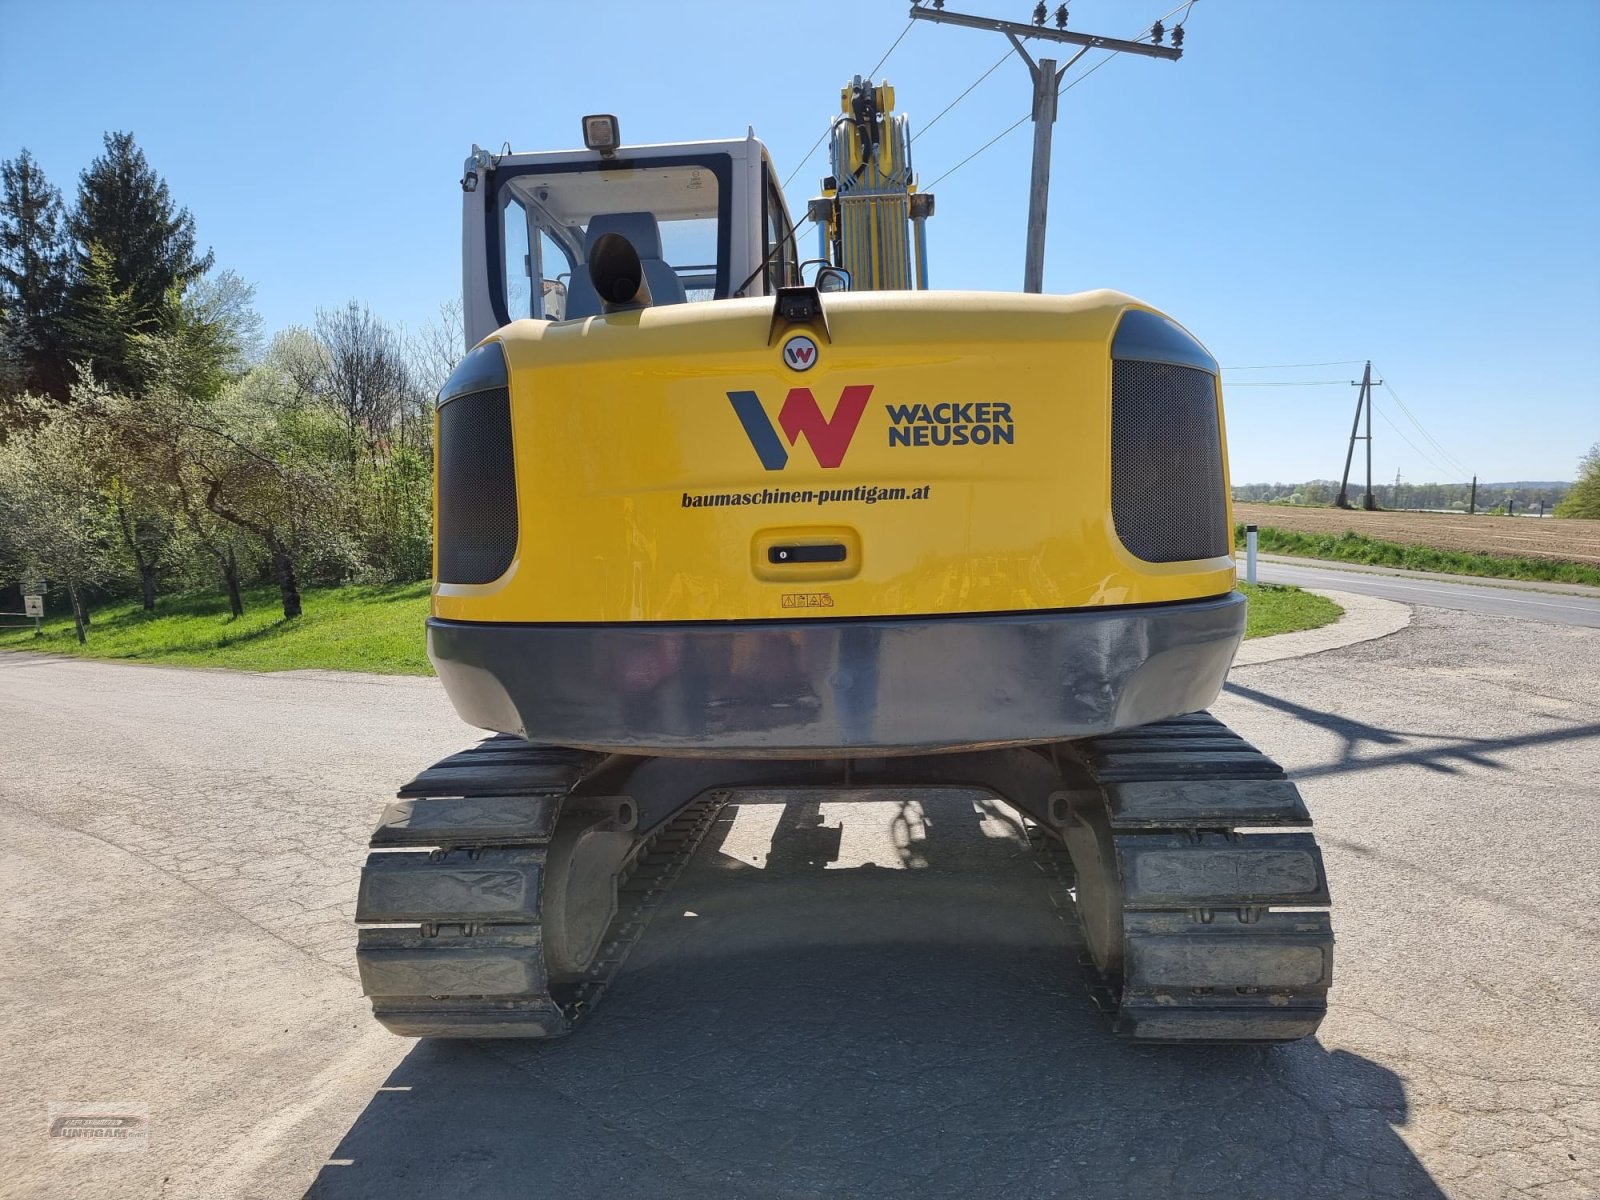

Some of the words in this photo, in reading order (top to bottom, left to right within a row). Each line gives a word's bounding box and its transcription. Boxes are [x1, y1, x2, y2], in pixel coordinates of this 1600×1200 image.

[886, 403, 1013, 425] WACKER
[726, 385, 874, 470] W
[889, 423, 1014, 447] NEUSON
[682, 485, 930, 508] baumaschinen-puntigam.at
